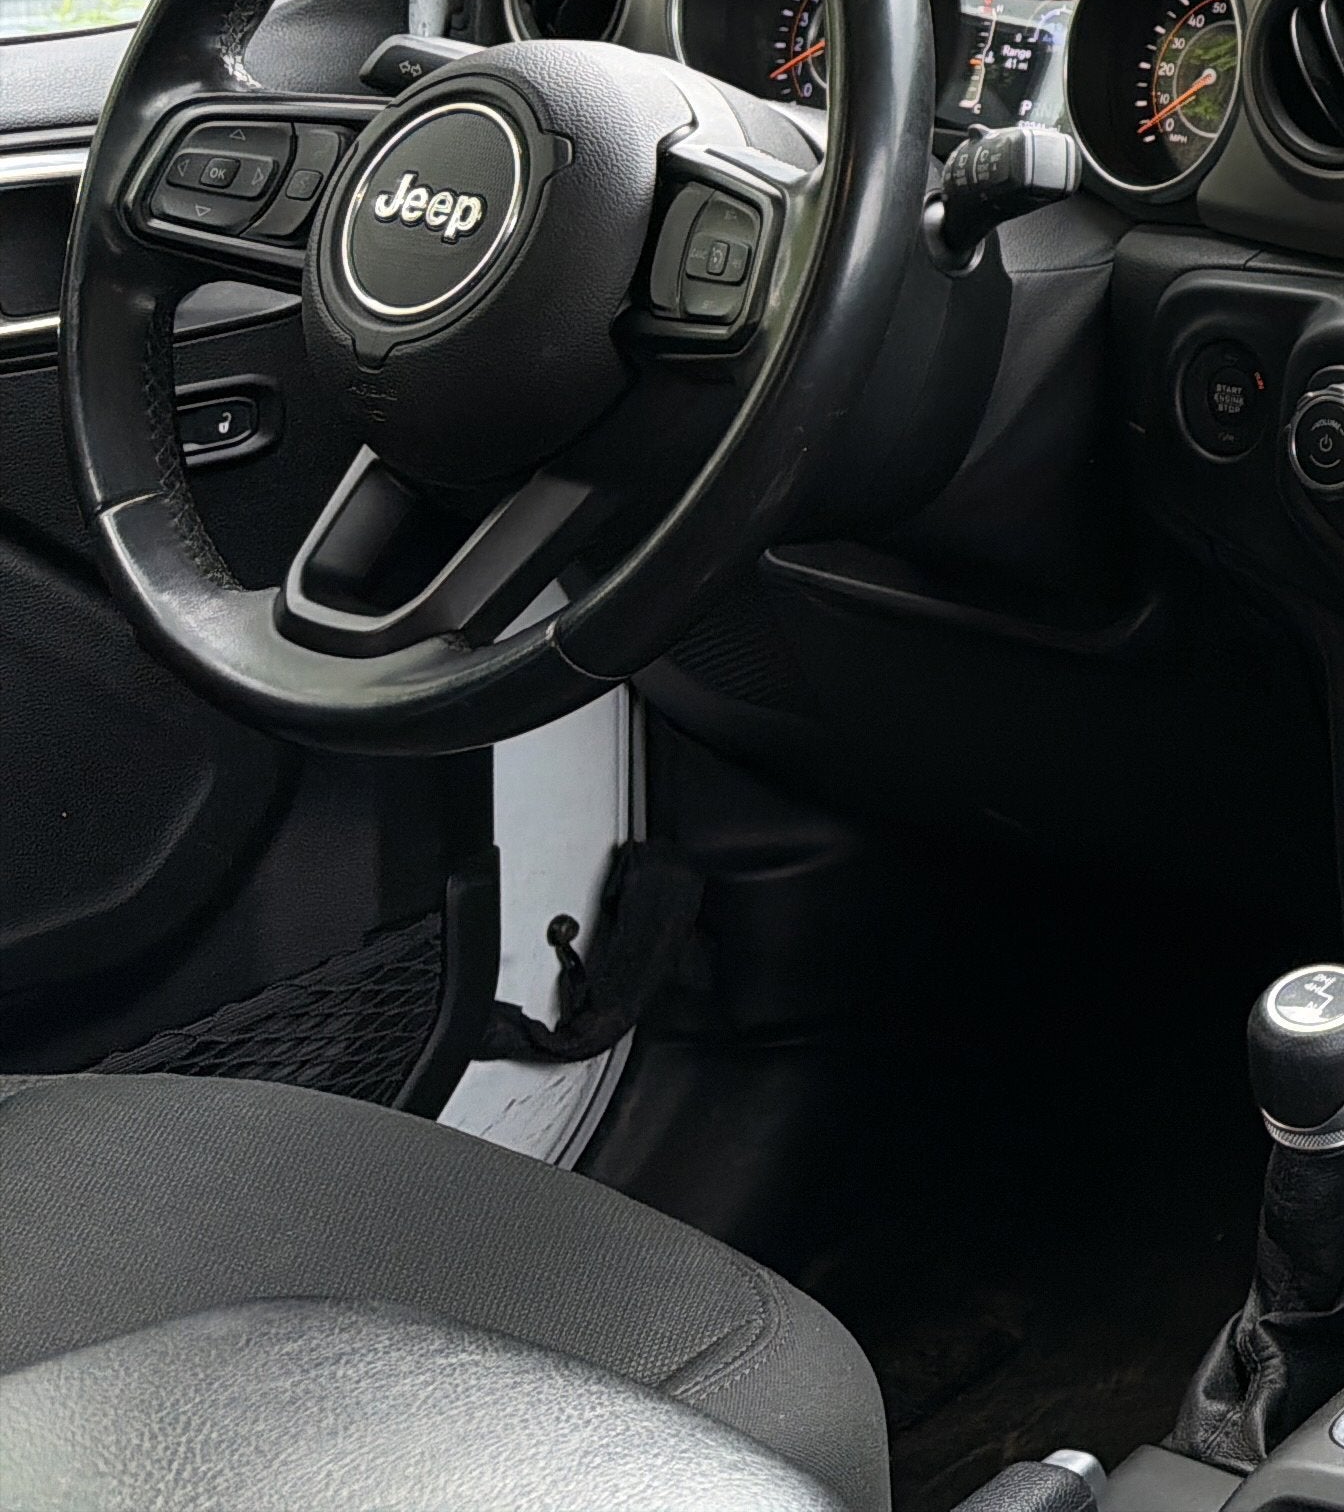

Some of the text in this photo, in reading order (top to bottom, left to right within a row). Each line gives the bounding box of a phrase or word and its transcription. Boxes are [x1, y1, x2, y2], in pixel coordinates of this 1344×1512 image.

[1212, 2, 1227, 14] 50
[1187, 14, 1205, 28] 40
[793, 37, 804, 52] 2
[1172, 38, 1186, 50] 30
[1002, 44, 1032, 60] Range
[1158, 62, 1174, 76] 20
[803, 83, 813, 97] 0
[1159, 93, 1170, 105] 10
[1165, 118, 1174, 132] 0
[1169, 133, 1188, 144] MPH
[209, 167, 226, 180] OK
[374, 171, 485, 243] Jeep
